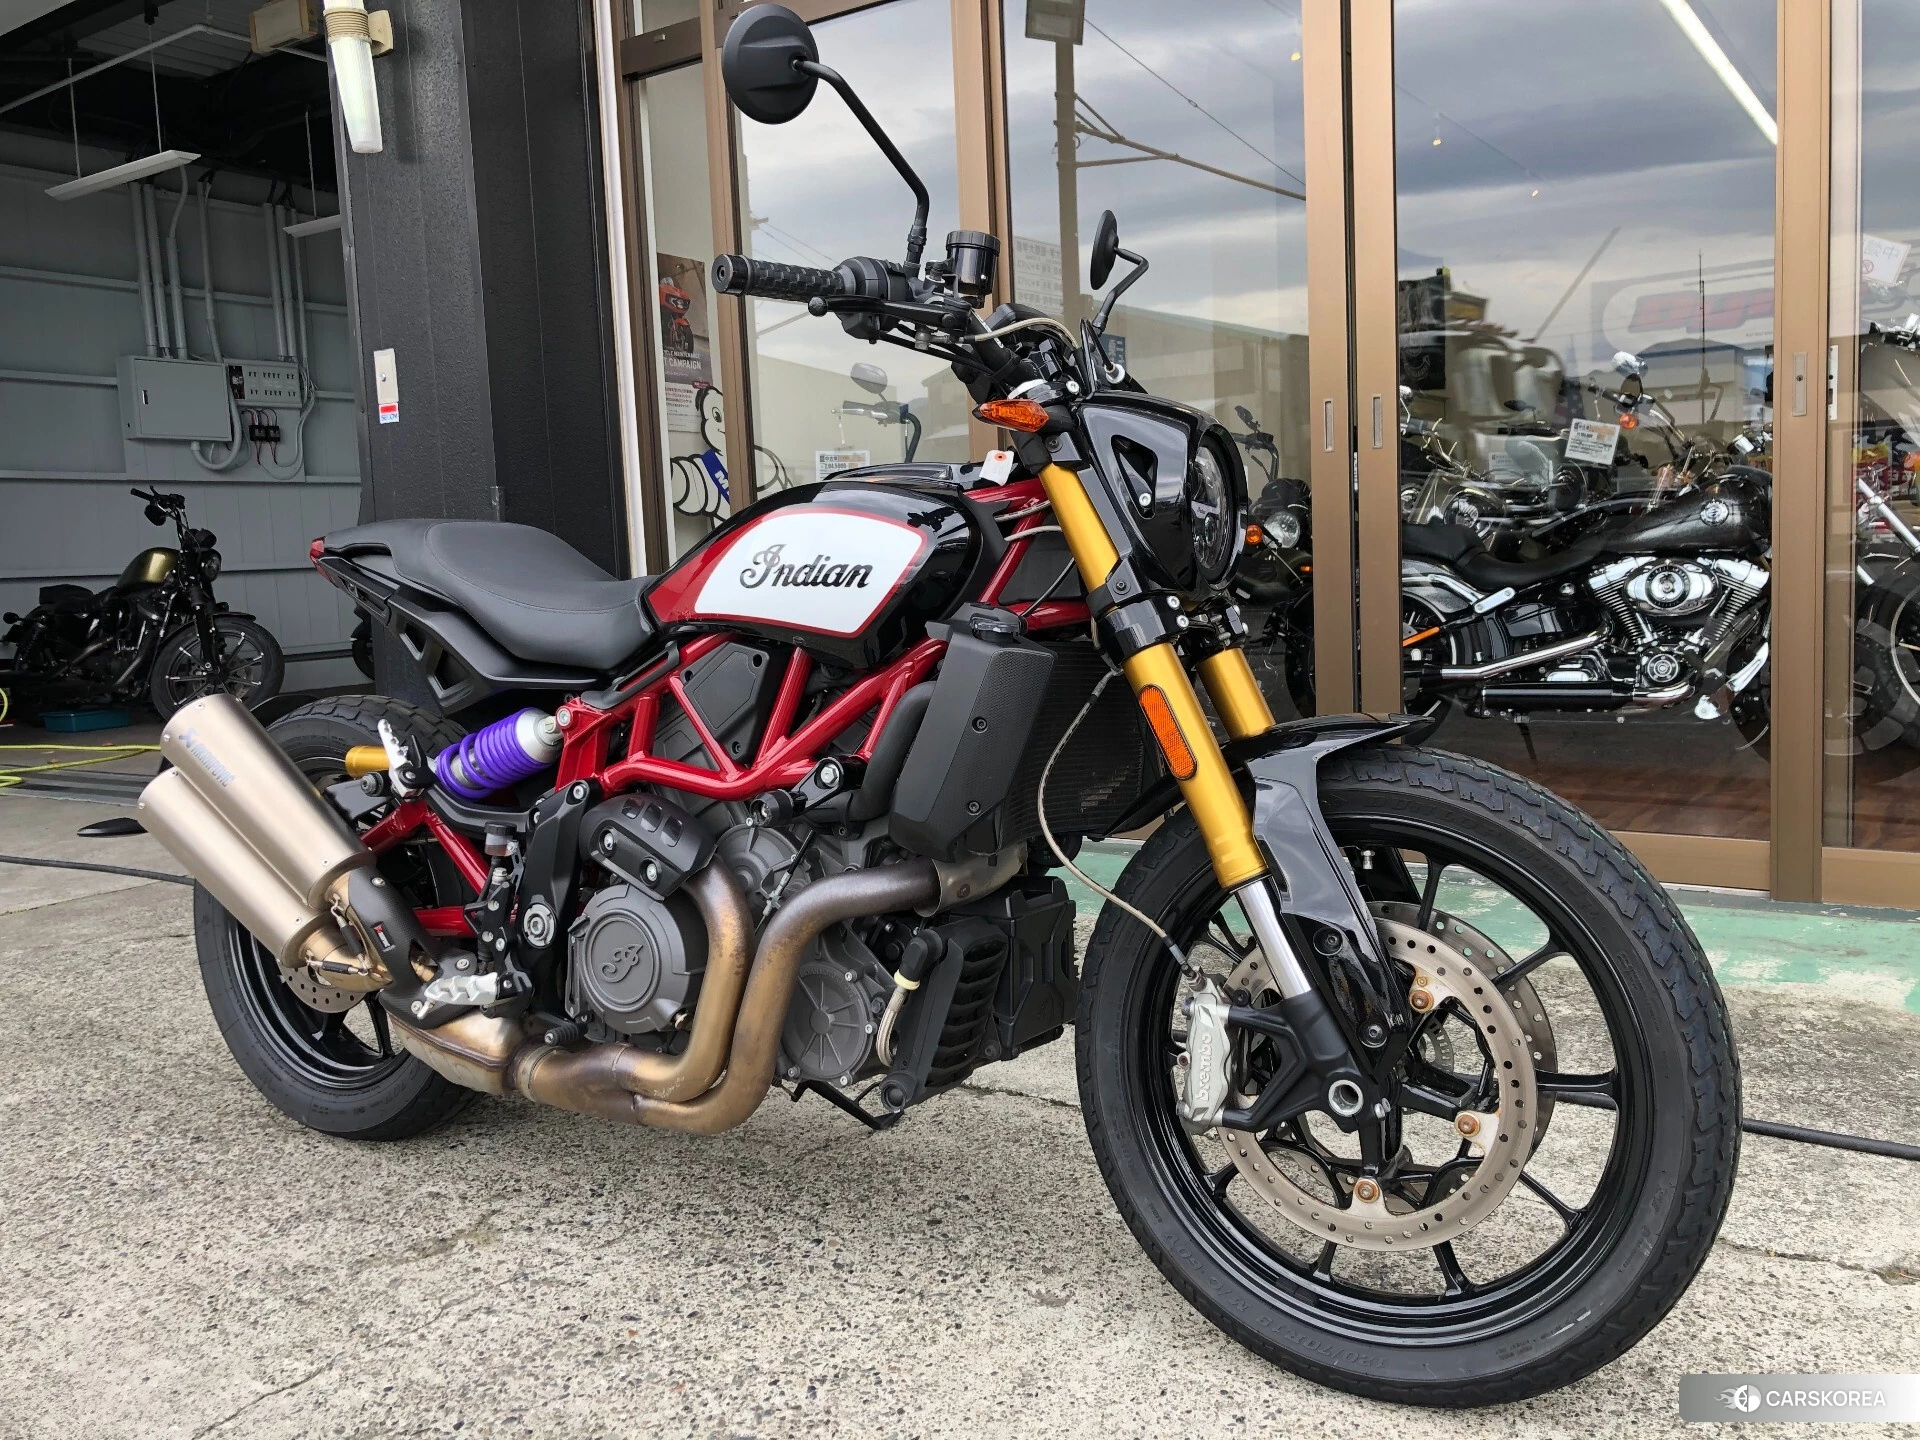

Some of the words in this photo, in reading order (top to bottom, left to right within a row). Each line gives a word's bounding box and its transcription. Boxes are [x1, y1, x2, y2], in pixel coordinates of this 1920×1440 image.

[669, 357, 702, 370] CAMPAIGN
[739, 543, 873, 588] Indian
[1195, 1033, 1212, 1101] brembo
